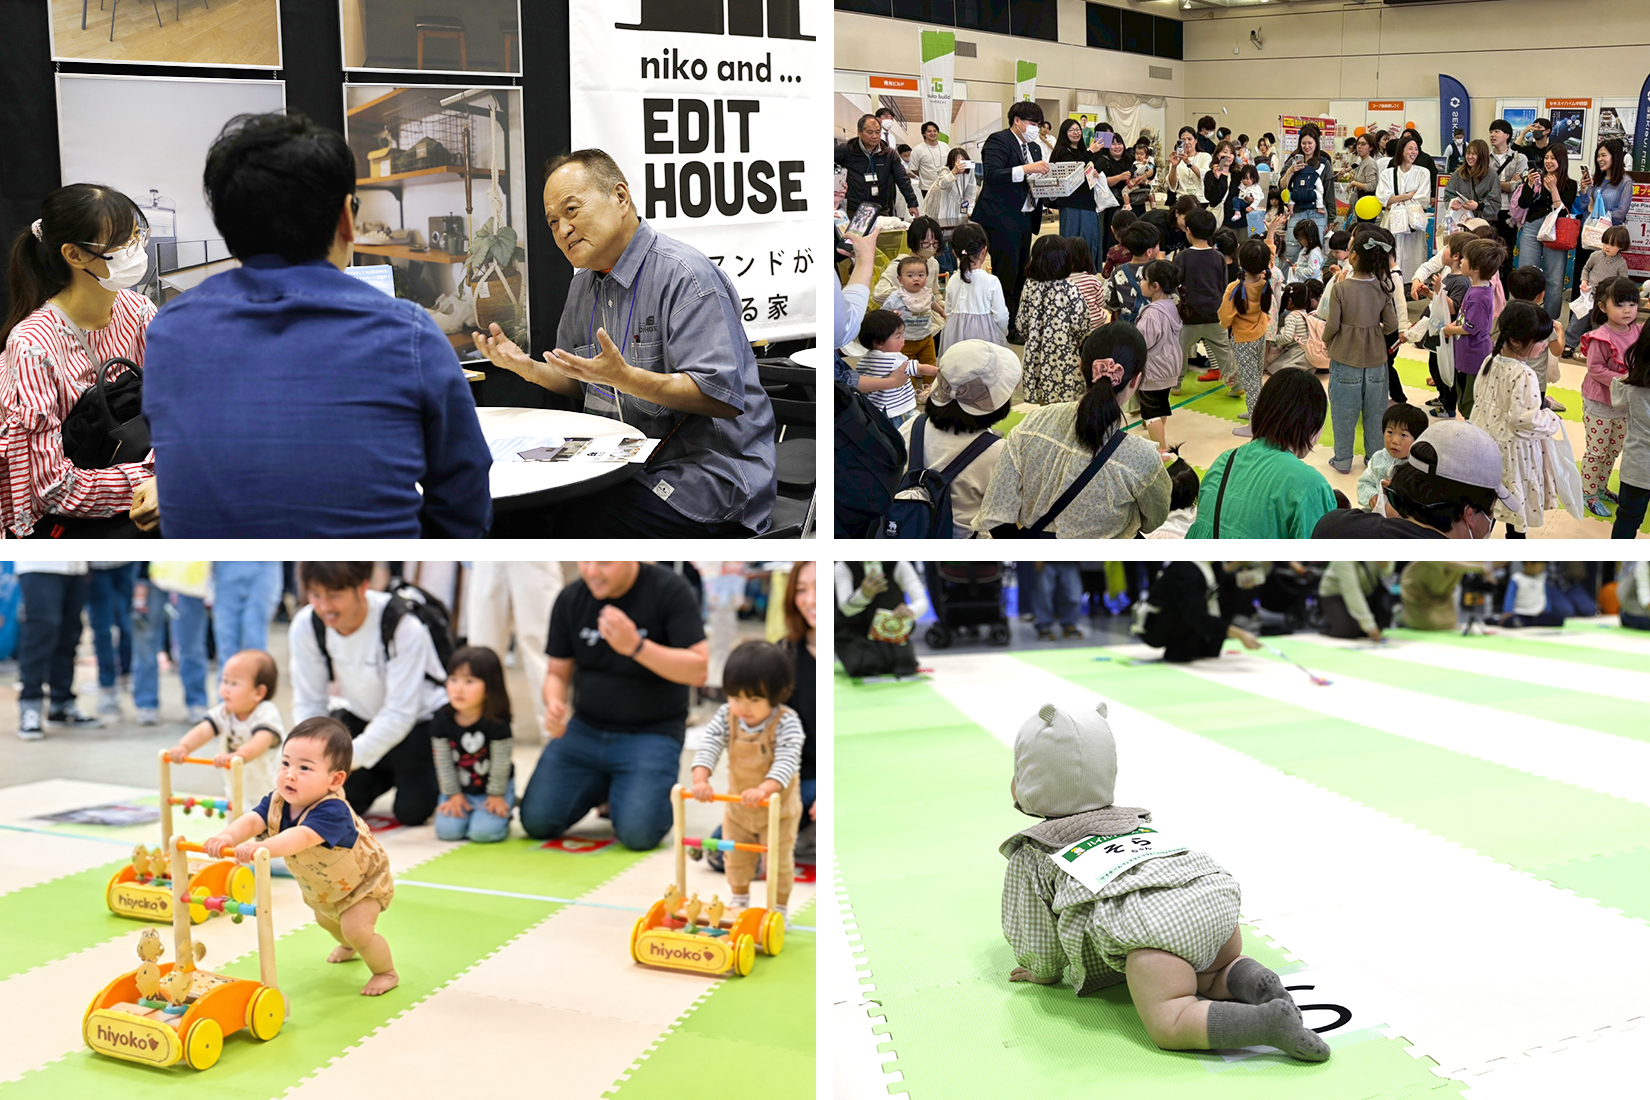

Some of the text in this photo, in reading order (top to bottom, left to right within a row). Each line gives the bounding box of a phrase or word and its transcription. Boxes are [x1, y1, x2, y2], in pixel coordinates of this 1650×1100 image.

[641, 48, 708, 80] niko
[717, 52, 772, 82] and
[643, 97, 760, 154] EDIT
[645, 160, 808, 219] HOUSE
[741, 293, 789, 322] る家
[1104, 837, 1152, 854] そら
[650, 942, 702, 961] hiyoko
[97, 1024, 148, 1050] hiyoko
